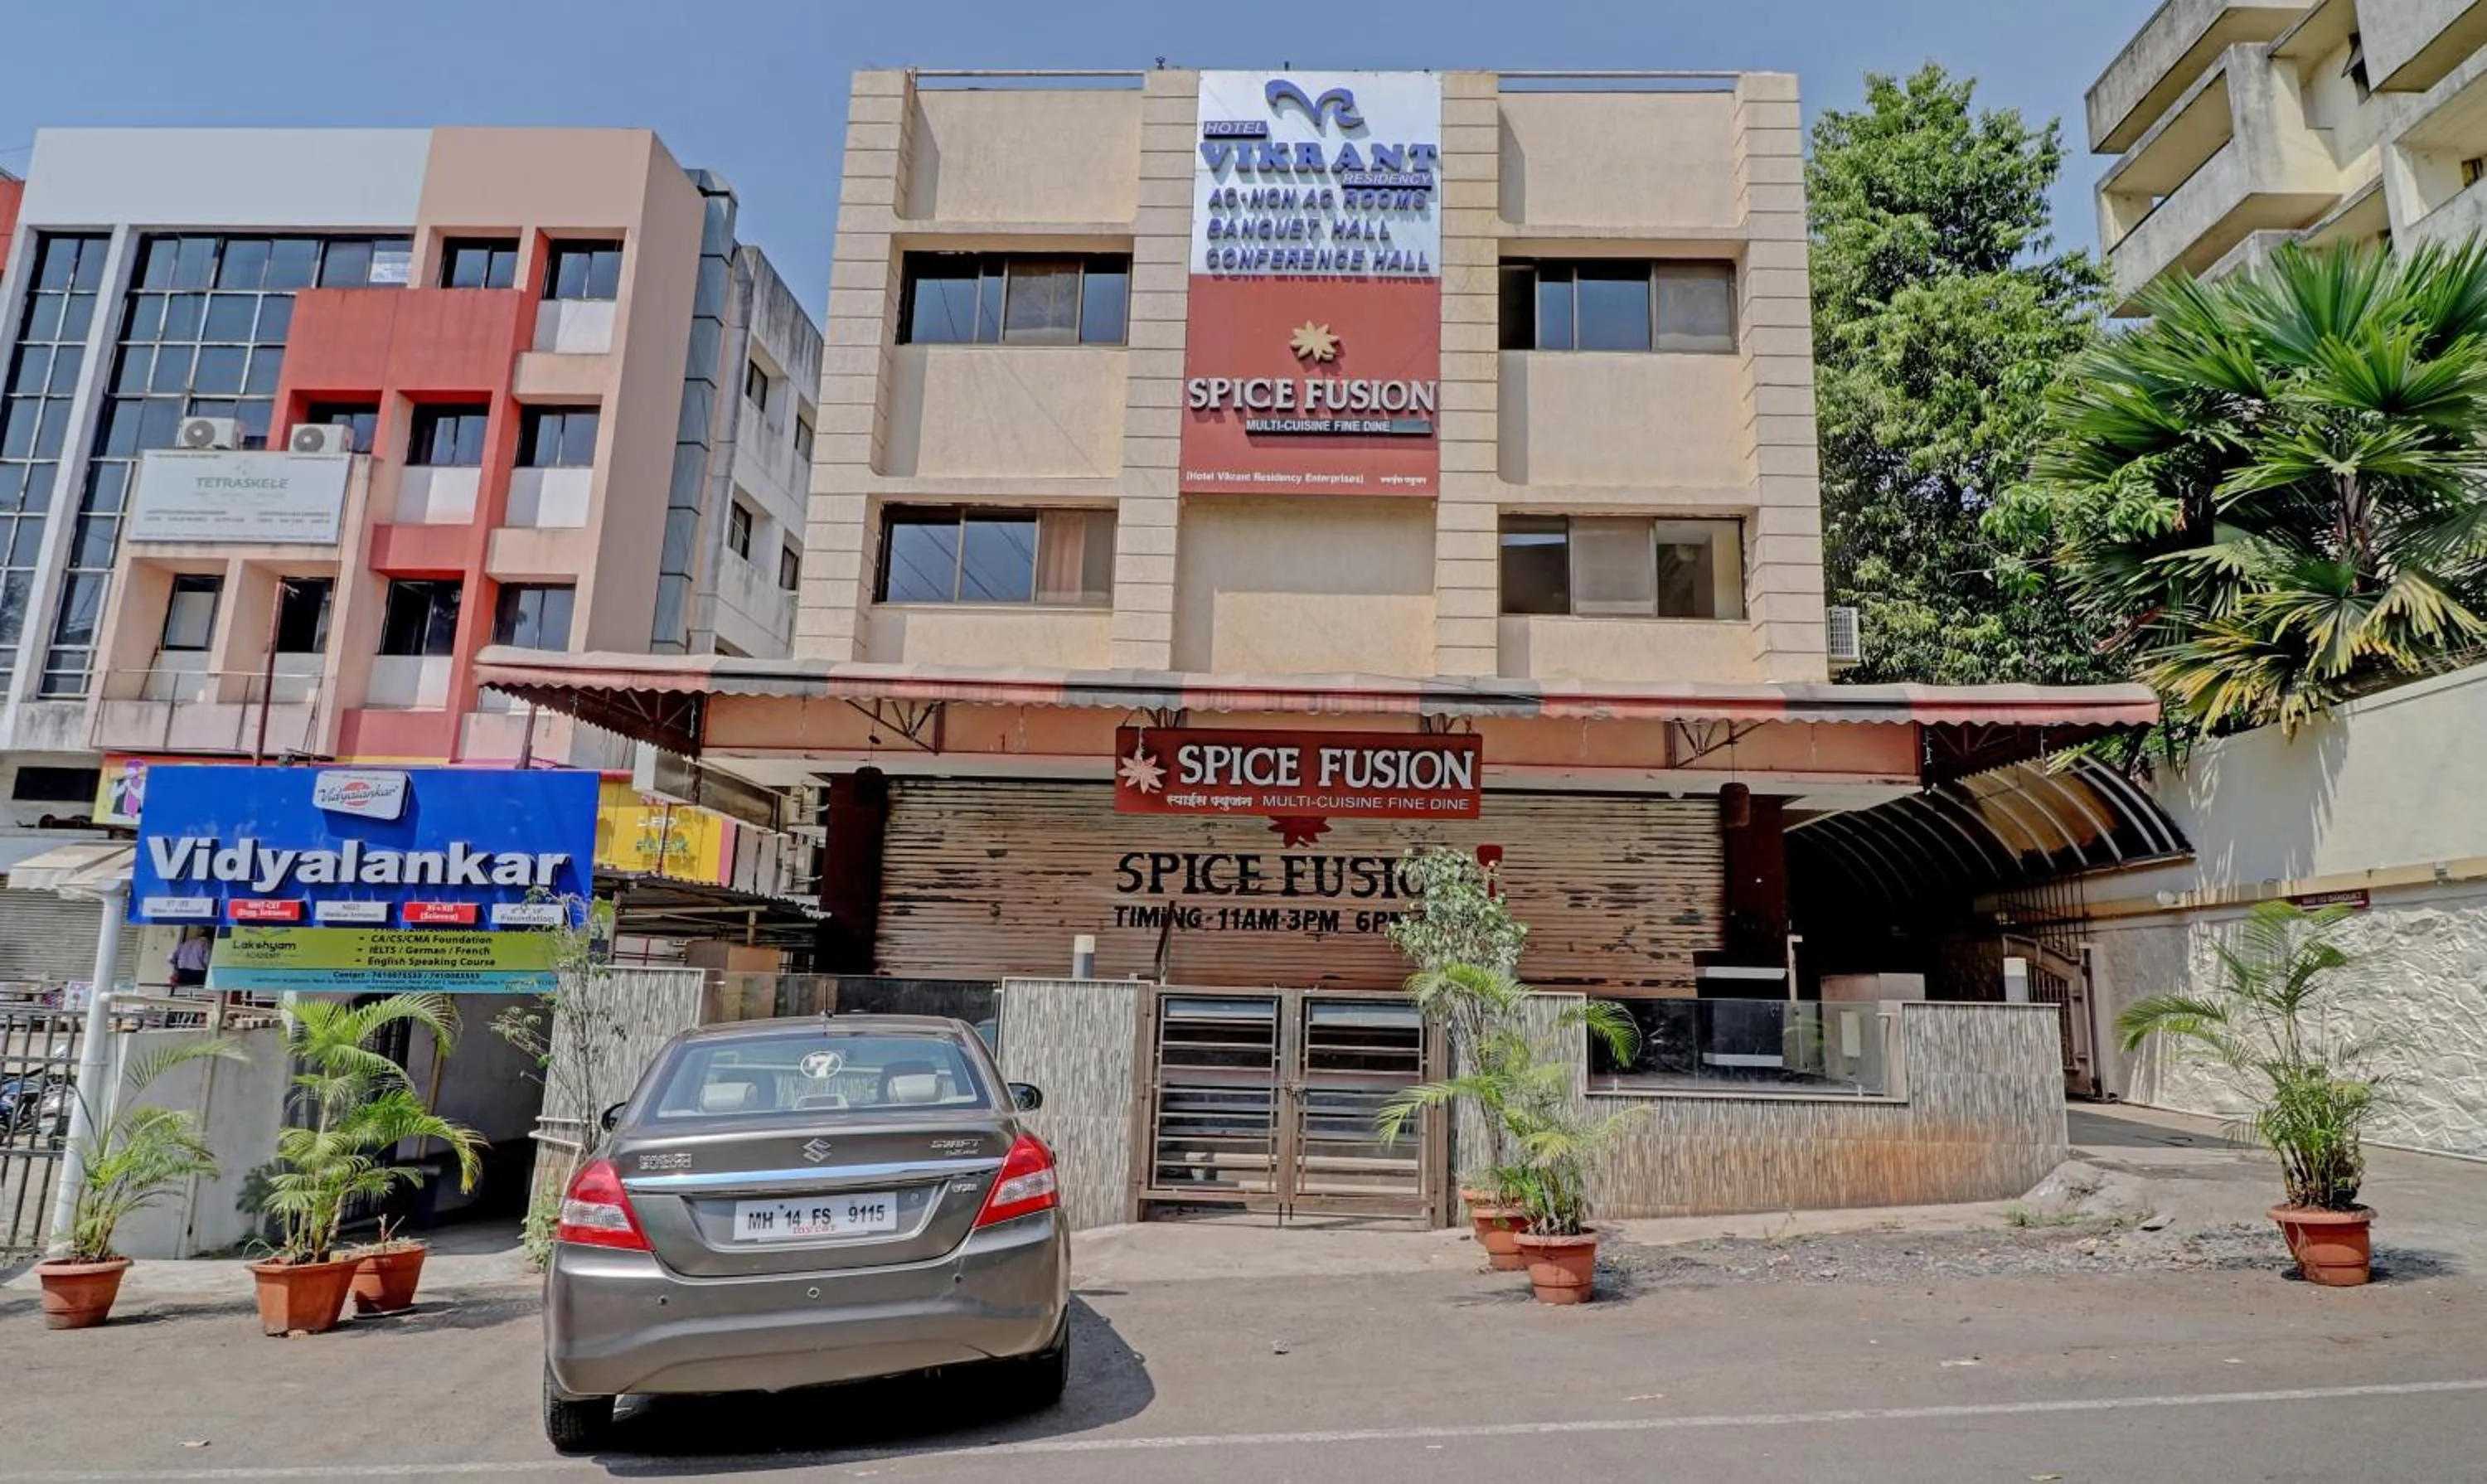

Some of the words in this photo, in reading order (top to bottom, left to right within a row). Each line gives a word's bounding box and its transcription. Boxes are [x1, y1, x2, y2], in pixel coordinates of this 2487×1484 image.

[1205, 121, 1267, 134] HOTEL
[1200, 142, 1437, 172] VIKRANT
[1342, 173, 1432, 186] RESIDENCY
[1302, 188, 1335, 210] AC
[1344, 190, 1427, 211] ROOMS
[1207, 219, 1321, 240] BANQUET
[1331, 220, 1390, 240] HALL
[1207, 249, 1365, 271] CONFERENCE
[1373, 251, 1429, 272] HALL
[1188, 377, 1296, 410] SPICE
[1304, 379, 1436, 412] FUSION
[1246, 419, 1331, 432] MULTI-CUISINE
[1335, 420, 1360, 432] FINE
[1364, 420, 1390, 432] DINE
[196, 478, 288, 489] TETRASKELE
[1253, 473, 1302, 485] Residency
[1178, 744, 1301, 786] SPICE
[1318, 748, 1475, 790] FUSION
[1263, 795, 1383, 810] MULTI-CUISINE
[1389, 797, 1424, 810] FINE
[1430, 798, 1469, 811] DINE
[147, 836, 570, 892] Vidyalankar
[1115, 851, 1262, 896] SPICE
[233, 939, 296, 952] Lakshyam
[433, 934, 493, 944] Foundation
[369, 946, 396, 954] IELTS
[406, 946, 447, 954] German
[456, 946, 490, 955] French
[368, 957, 405, 968] English
[409, 958, 456, 968] Speaking
[460, 958, 496, 967] Course
[749, 1212, 773, 1229] MH
[785, 1210, 801, 1227] 14
[812, 1208, 831, 1225] FS
[849, 1205, 885, 1223] 9115
